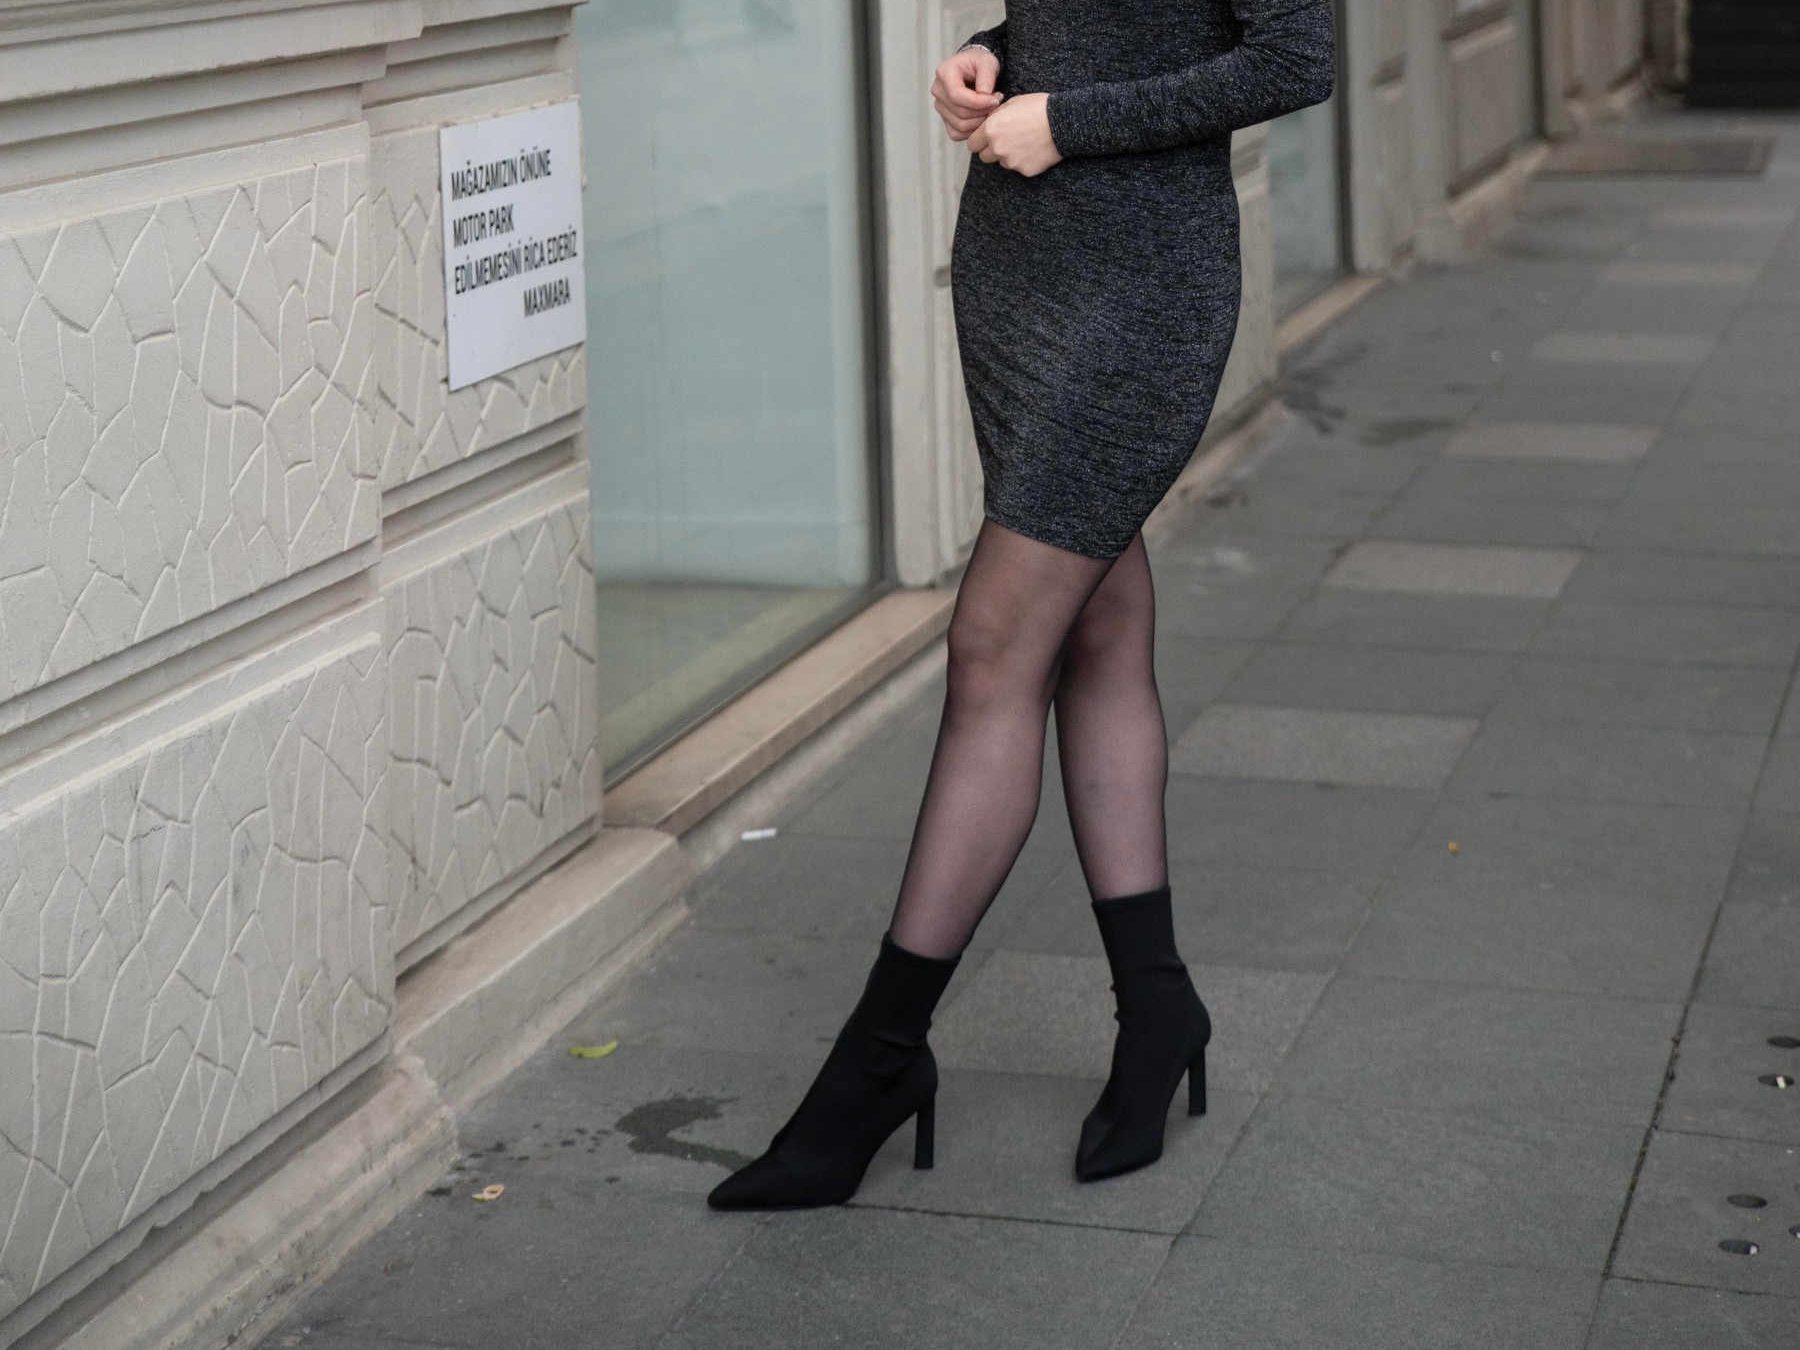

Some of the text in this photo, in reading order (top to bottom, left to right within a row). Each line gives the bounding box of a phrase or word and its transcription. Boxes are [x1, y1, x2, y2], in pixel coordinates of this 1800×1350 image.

[520, 146, 552, 183] ÖNÜNE
[453, 203, 514, 248] MOTOR PARK
[524, 236, 545, 275] RİCA
[547, 224, 578, 266] EDERİZ
[523, 277, 571, 318] MAXMARA
